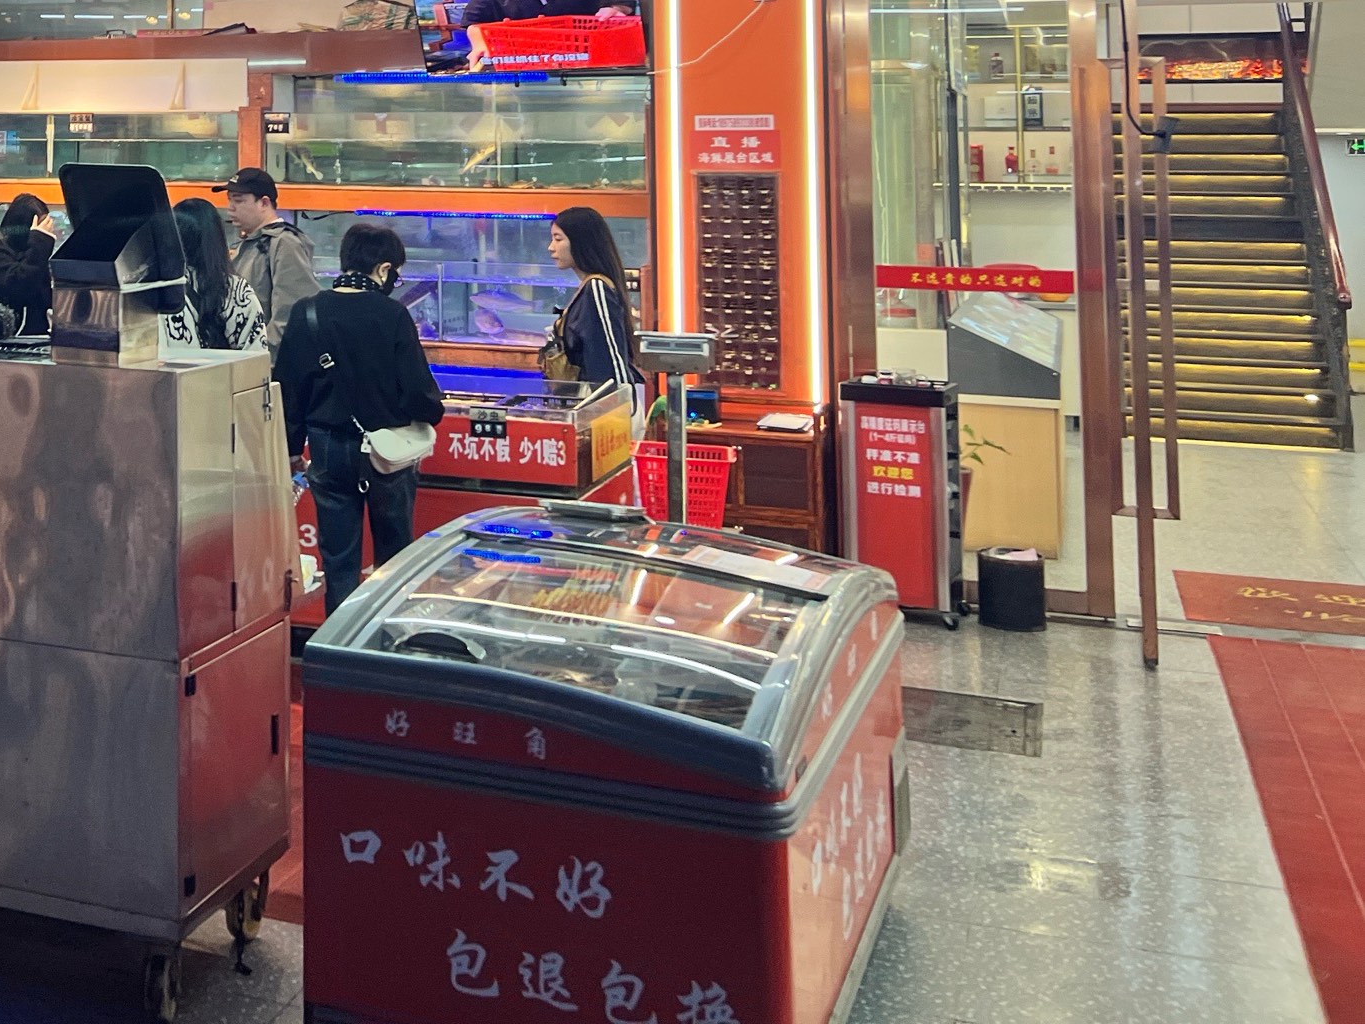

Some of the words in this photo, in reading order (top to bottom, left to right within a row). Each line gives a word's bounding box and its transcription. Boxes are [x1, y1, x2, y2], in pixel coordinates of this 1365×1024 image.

[518, 436, 566, 467] 少1赔3
[385, 708, 547, 761] 好旺角
[340, 830, 612, 919] 口味不好
[446, 929, 740, 1024] 包退包换
